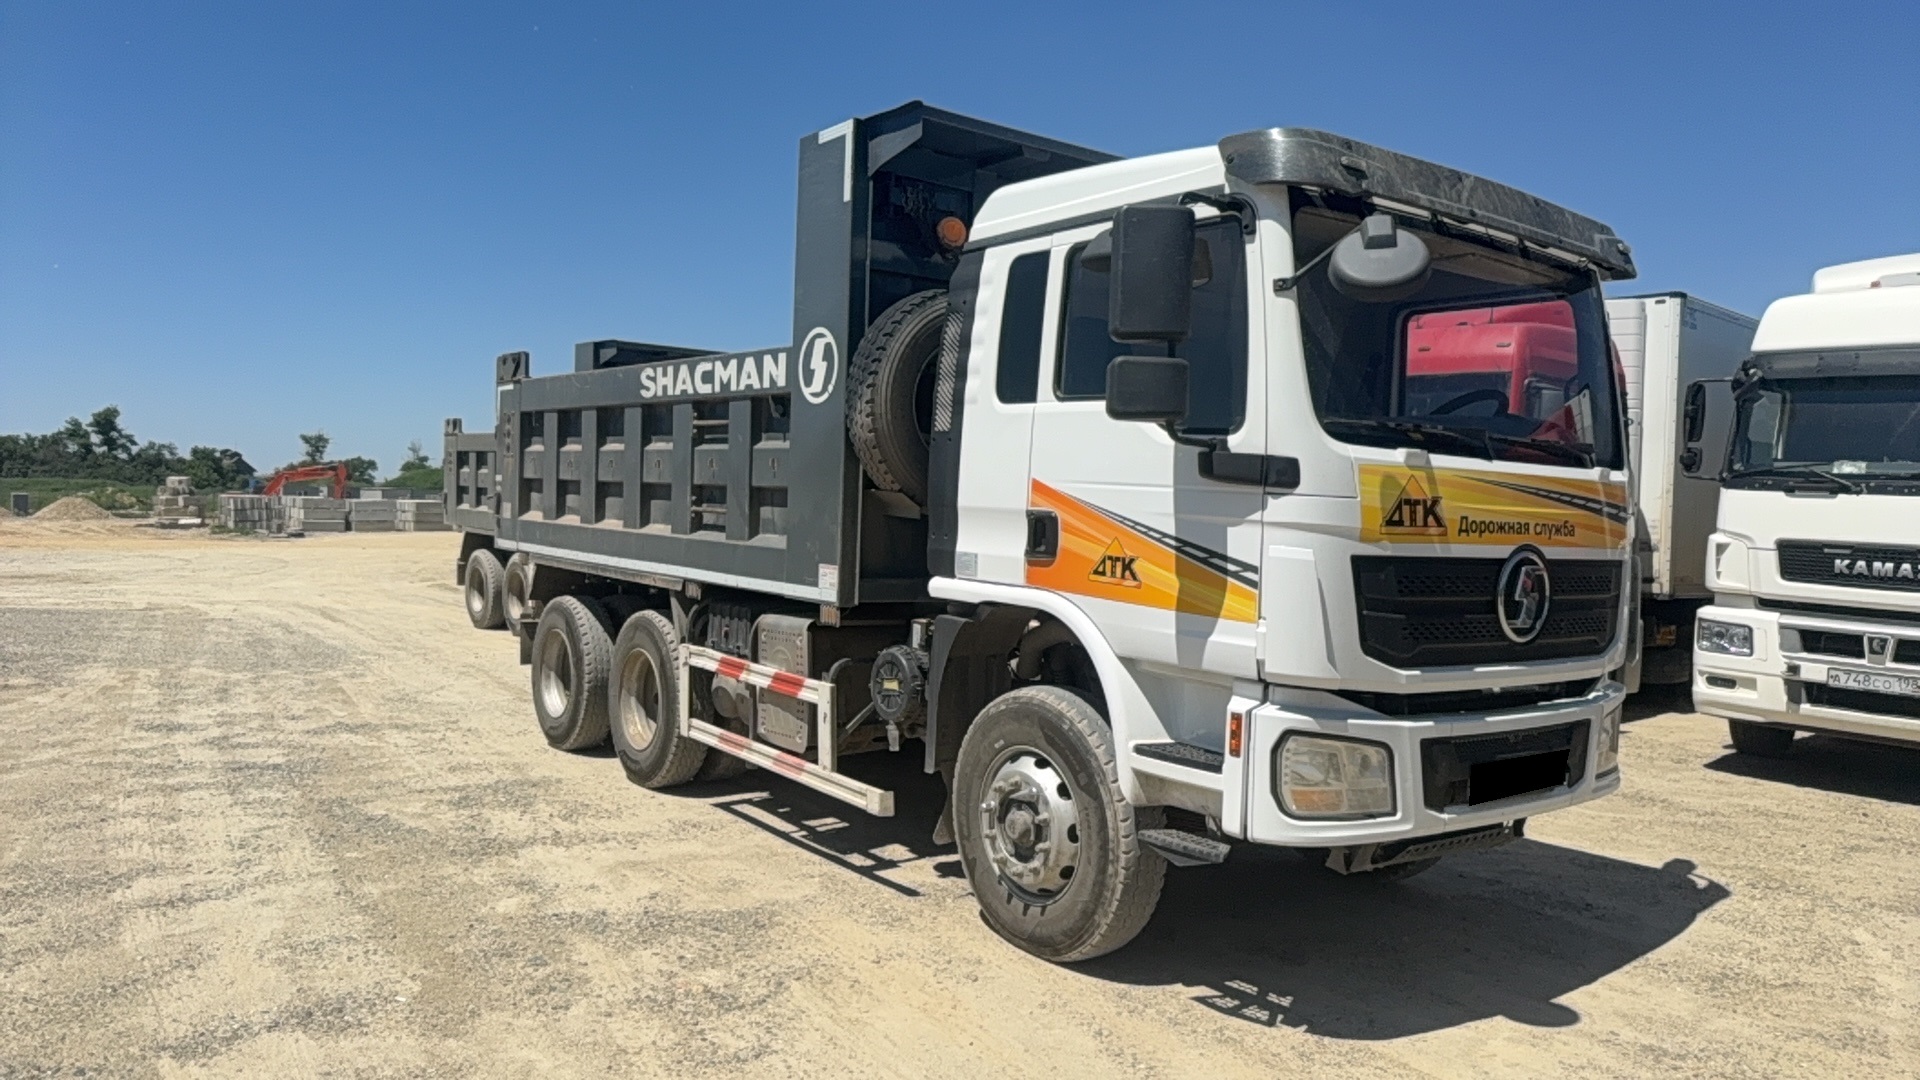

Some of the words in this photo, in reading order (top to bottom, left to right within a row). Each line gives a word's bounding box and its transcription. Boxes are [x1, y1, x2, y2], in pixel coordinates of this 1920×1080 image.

[640, 352, 787, 399] SHACMAN
[1458, 516, 1530, 538] Дорожная
[1533, 520, 1576, 540] служба
[1834, 559, 1920, 579] KAMA
